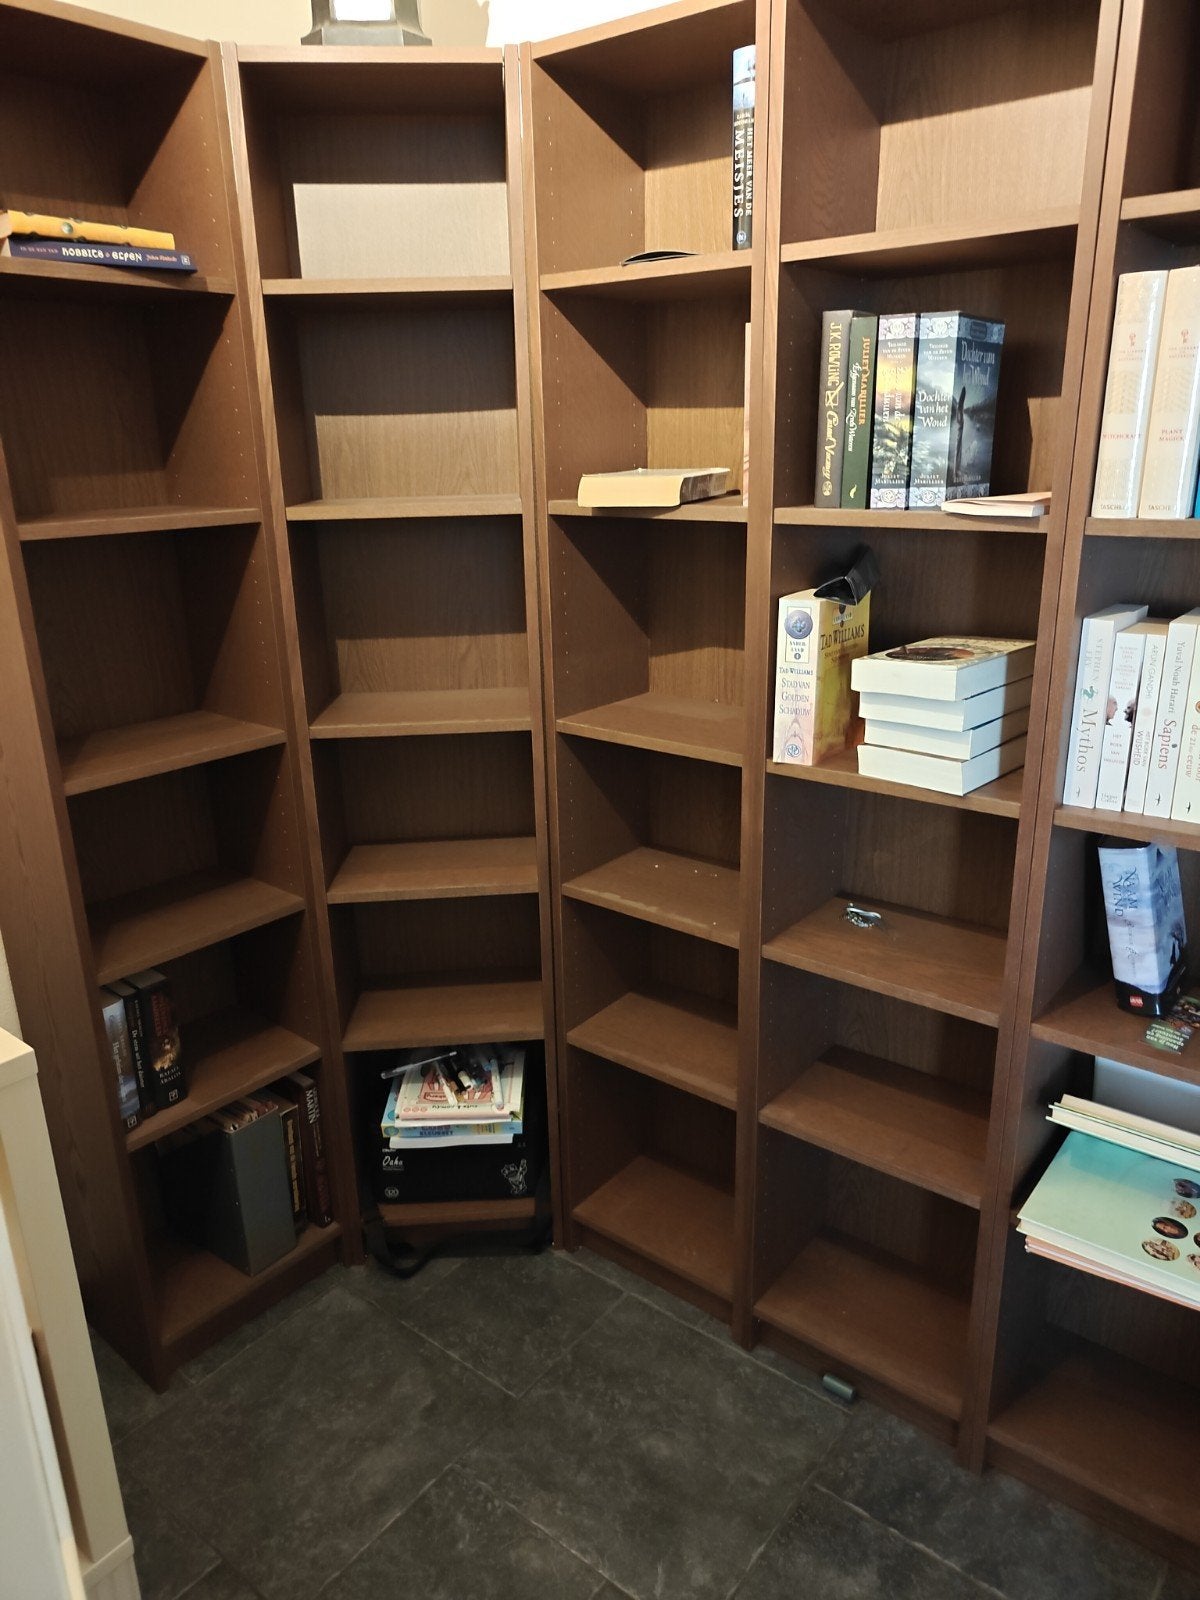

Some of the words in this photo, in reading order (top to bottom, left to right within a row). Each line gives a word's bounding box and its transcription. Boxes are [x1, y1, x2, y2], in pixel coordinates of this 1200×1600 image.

[734, 129, 744, 218] MEISJES
[745, 202, 752, 216] DE
[862, 336, 871, 369] JULIET
[857, 370, 870, 426] MARILLIER
[918, 389, 951, 402] Dochter
[936, 401, 949, 413] het
[917, 416, 948, 428] Woud
[820, 634, 832, 651] TAD
[833, 623, 865, 645] WILLIAMS
[1175, 641, 1186, 664] Yuval
[1171, 665, 1183, 687] Noah
[781, 691, 810, 703] GOUDEN
[1168, 688, 1179, 714] Harari
[1076, 708, 1099, 775] Mythos
[1191, 724, 1200, 735] de
[1158, 718, 1178, 770] Sapiens
[1185, 755, 1194, 778] eeuw
[1112, 875, 1124, 917] WIND
[306, 1090, 315, 1124] MARTIN
